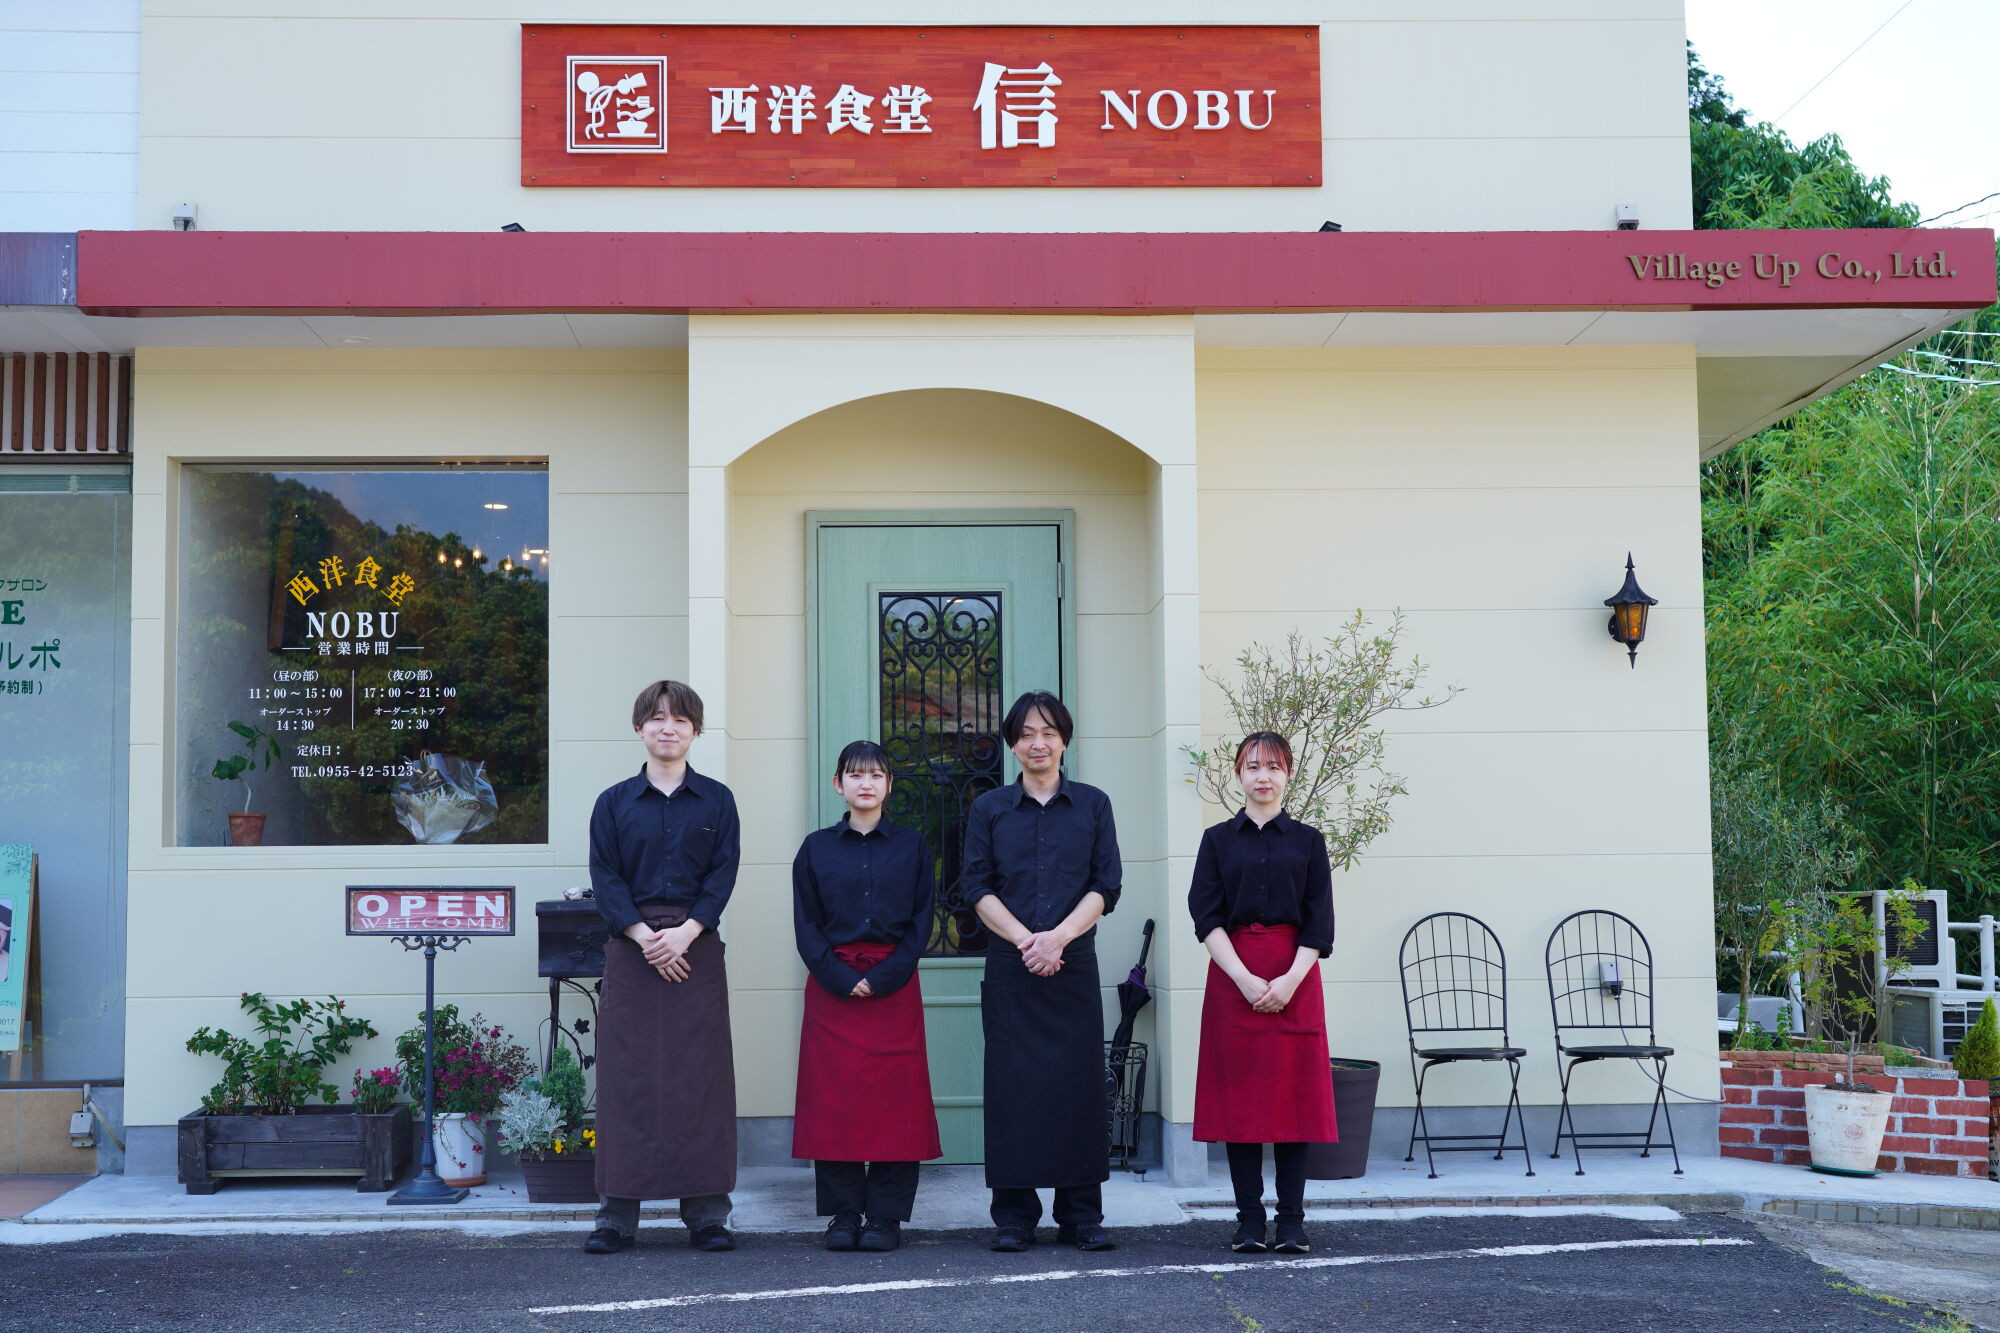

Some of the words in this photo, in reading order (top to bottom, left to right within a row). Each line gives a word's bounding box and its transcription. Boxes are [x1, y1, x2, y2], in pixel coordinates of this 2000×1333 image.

[708, 83, 933, 135] 西洋食堂
[973, 61, 1062, 149] 信
[1100, 89, 1277, 131] NOBU
[1627, 253, 1742, 288] Village
[1752, 253, 1800, 287] Up
[1817, 252, 1881, 283] Co.,
[1890, 251, 1957, 278] Ltd.
[284, 555, 415, 606] 西洋食堂
[305, 611, 400, 639] NOBU
[317, 641, 389, 656] 営業時間
[259, 707, 332, 716] オーダーストップ
[374, 706, 446, 716] オーダーストップ
[357, 894, 505, 917] OPEN
[358, 917, 505, 929] WELCOME
